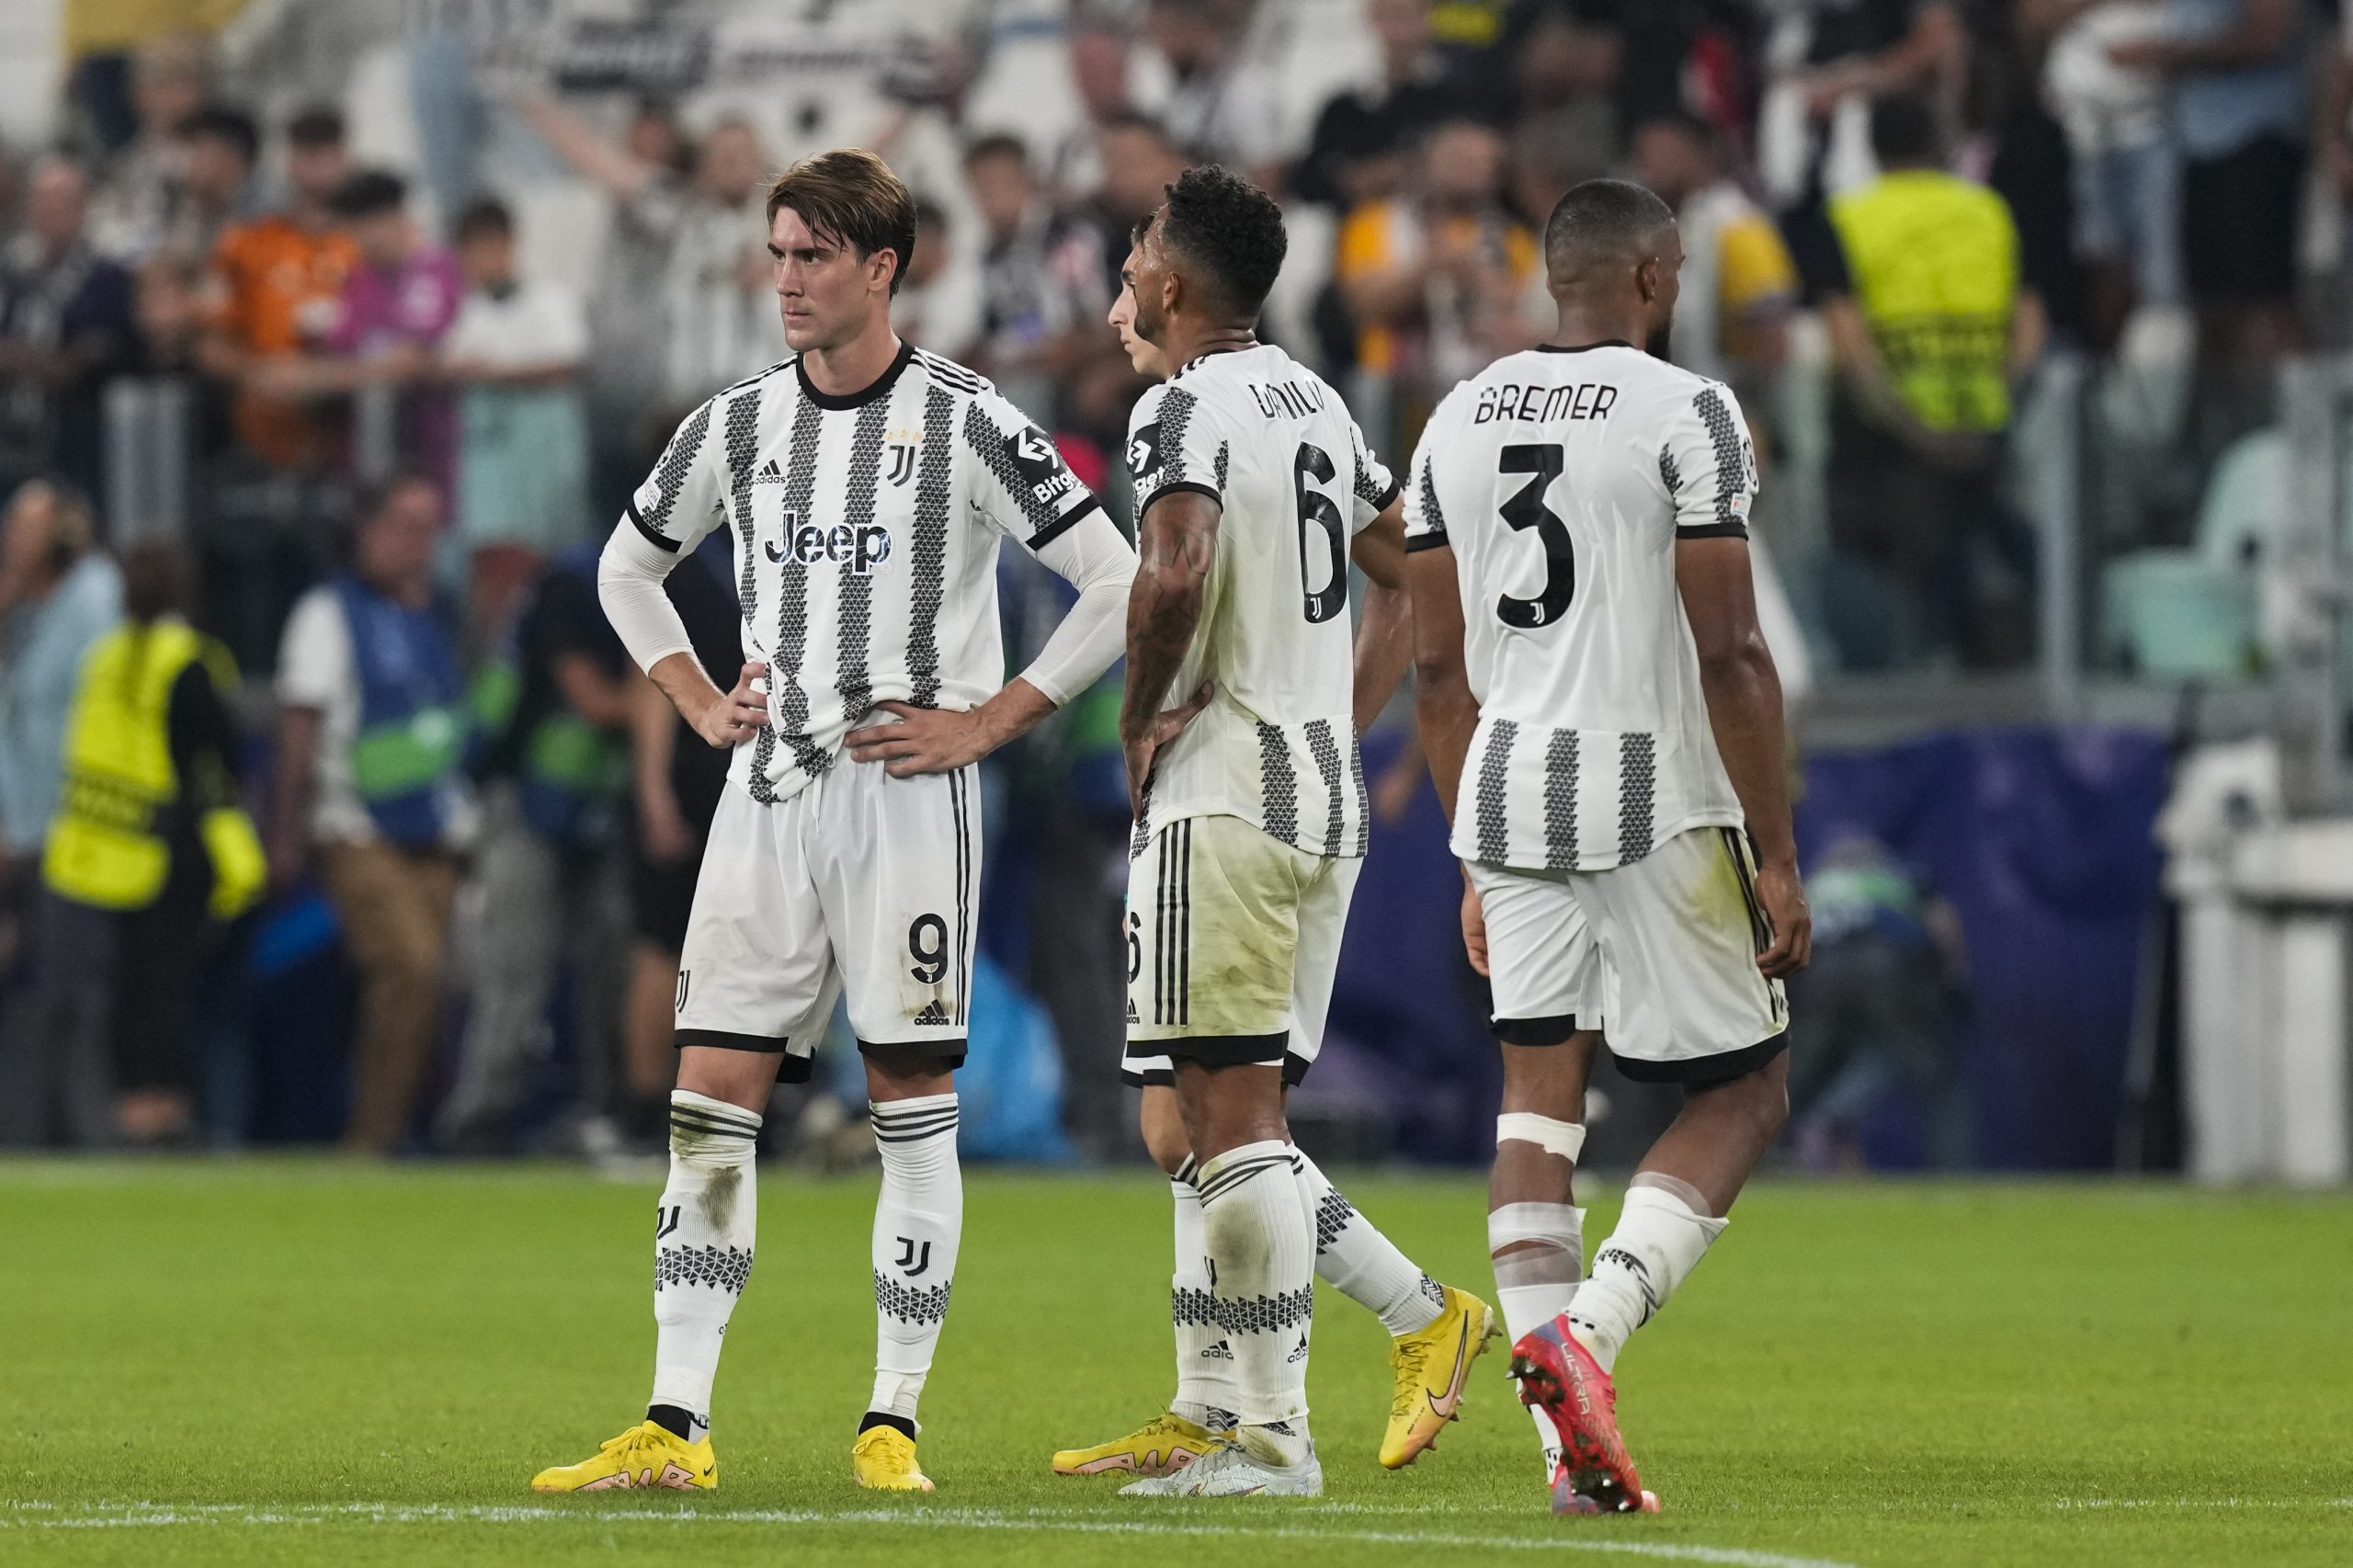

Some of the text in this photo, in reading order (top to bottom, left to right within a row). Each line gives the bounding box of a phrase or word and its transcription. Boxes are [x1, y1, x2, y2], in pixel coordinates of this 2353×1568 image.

[1474, 384, 1618, 425] BREMER
[754, 474, 786, 485] adidas
[1032, 471, 1075, 505] Bitg
[1134, 465, 1165, 496] get
[764, 511, 892, 574] Jeep
[1294, 441, 1347, 625] 6
[1496, 444, 1574, 629] 3
[909, 912, 949, 984] 9
[915, 1013, 949, 1026] adidas
[1200, 1346, 1234, 1361] adid
